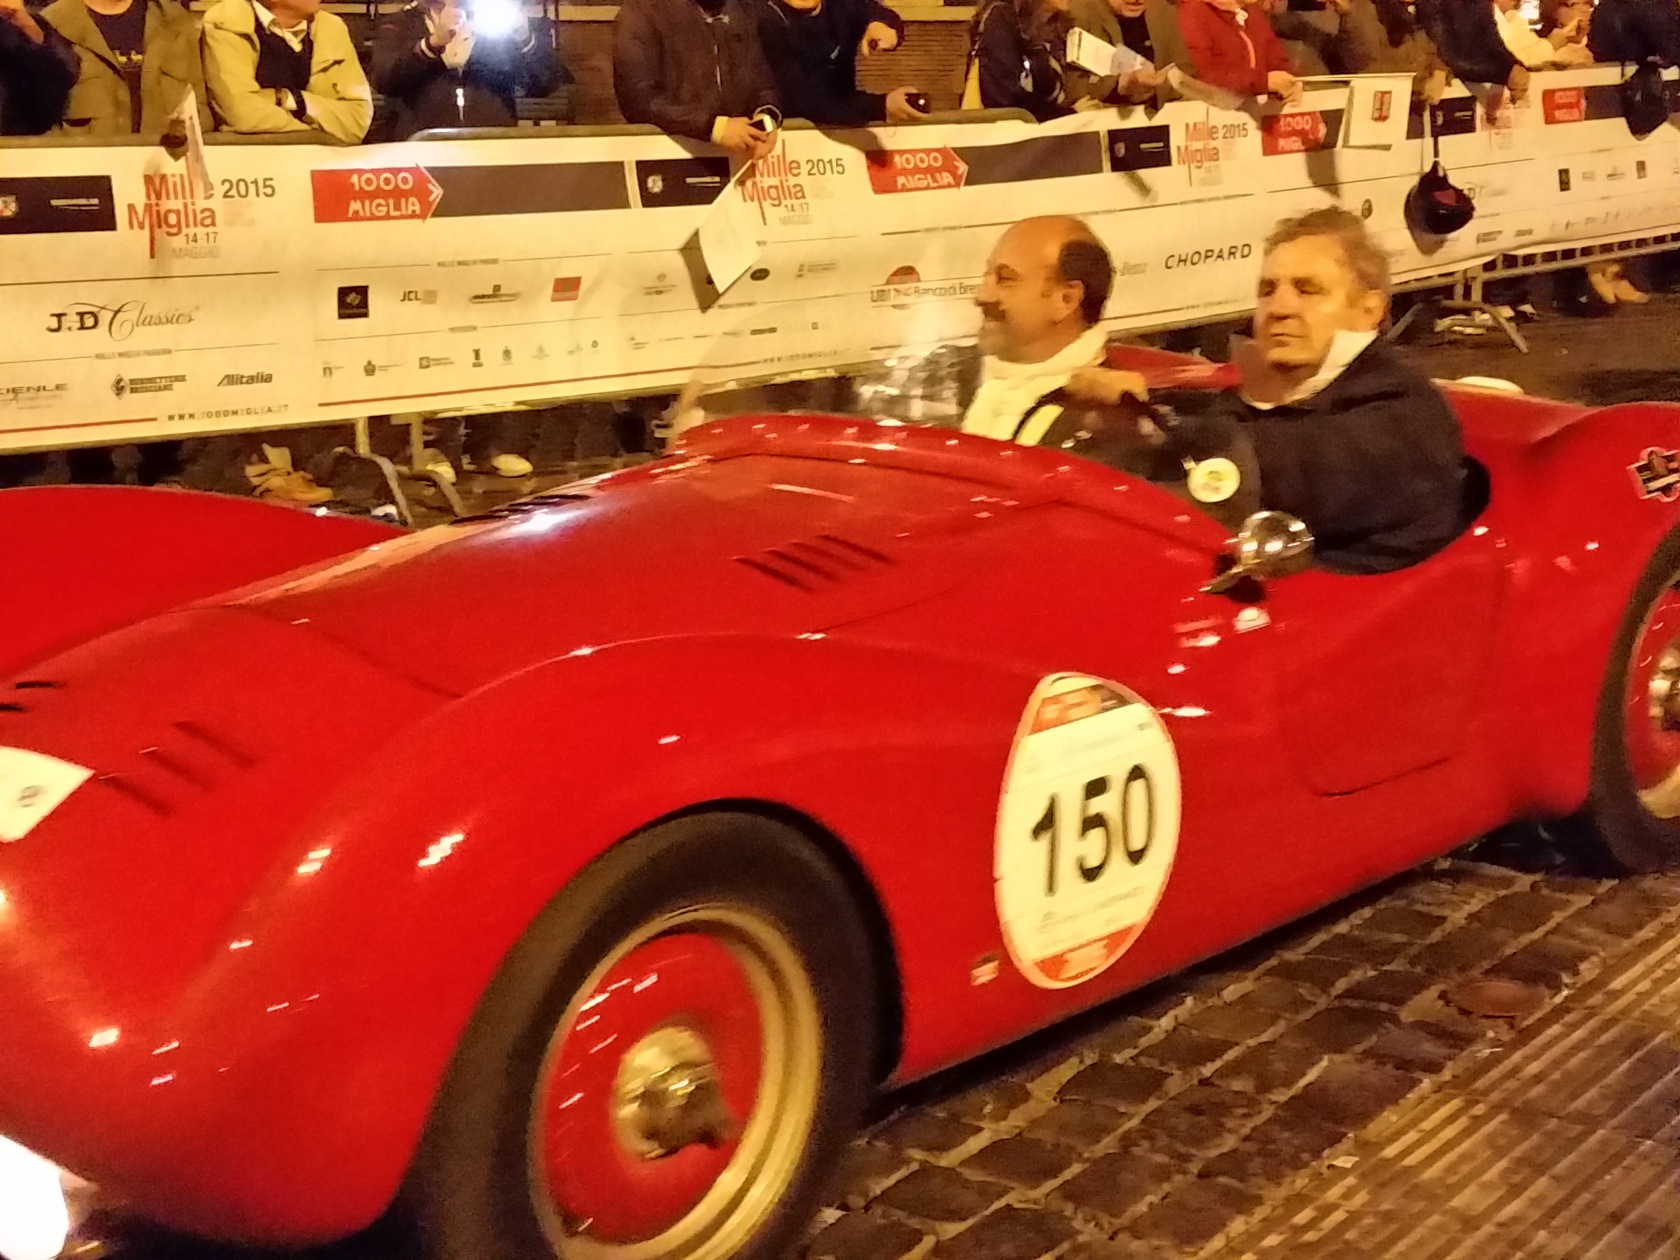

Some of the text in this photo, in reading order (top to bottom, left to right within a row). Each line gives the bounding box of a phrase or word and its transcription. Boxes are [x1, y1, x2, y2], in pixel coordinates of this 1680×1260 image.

[1221, 122, 1249, 140] 2015
[1279, 115, 1312, 132] 1000
[1278, 136, 1306, 152] MIGL
[753, 139, 846, 178] Mille 2015
[893, 152, 943, 169] 1000
[1176, 142, 1220, 183] Miglia
[221, 177, 276, 199] 2015
[349, 171, 414, 192] 1000
[895, 171, 955, 190] MIGLIA
[348, 196, 421, 218] MIGLIA
[741, 178, 807, 226] Miglia
[127, 201, 217, 258] Miglia
[1164, 243, 1252, 270] CHOPARD
[46, 300, 196, 342] J.D Classics
[217, 372, 273, 388] Alitalia
[1032, 762, 1156, 898] 150
